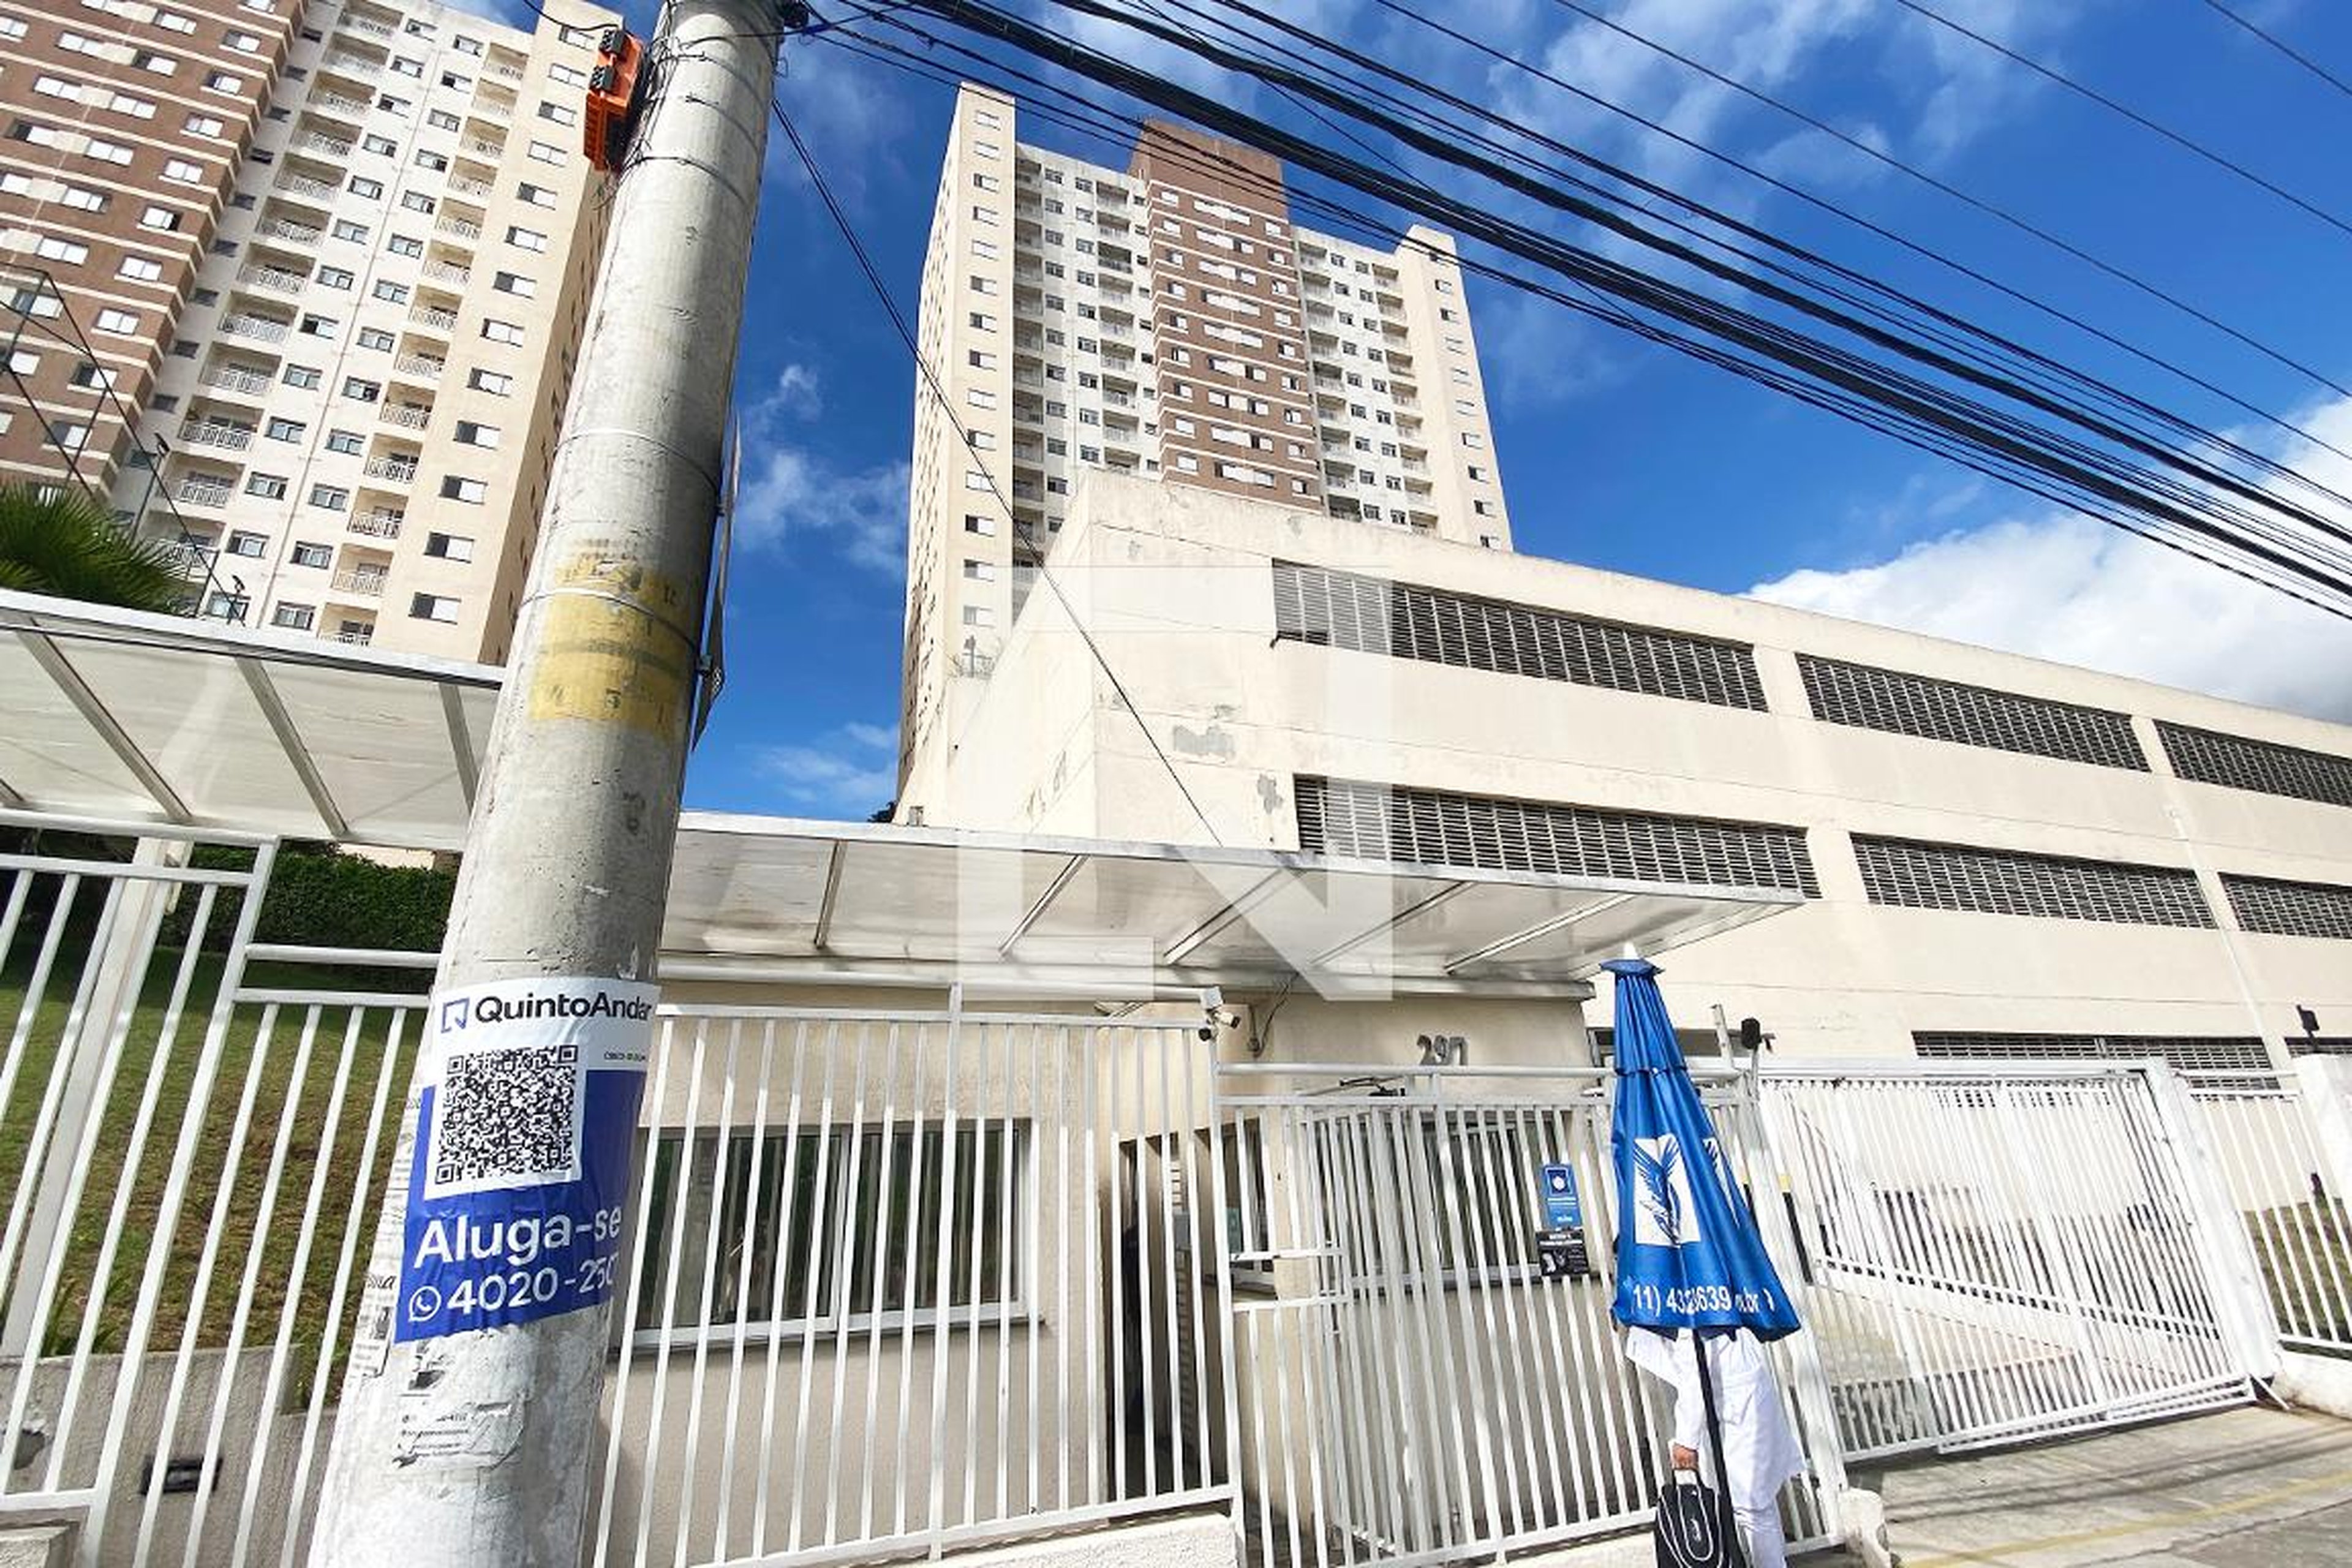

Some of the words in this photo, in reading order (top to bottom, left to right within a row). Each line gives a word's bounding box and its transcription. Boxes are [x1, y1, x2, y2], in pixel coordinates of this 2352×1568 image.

[475, 992, 652, 1024] QuintoAndar
[1417, 1035, 1468, 1066] 297
[414, 1206, 621, 1266] Aluga-se
